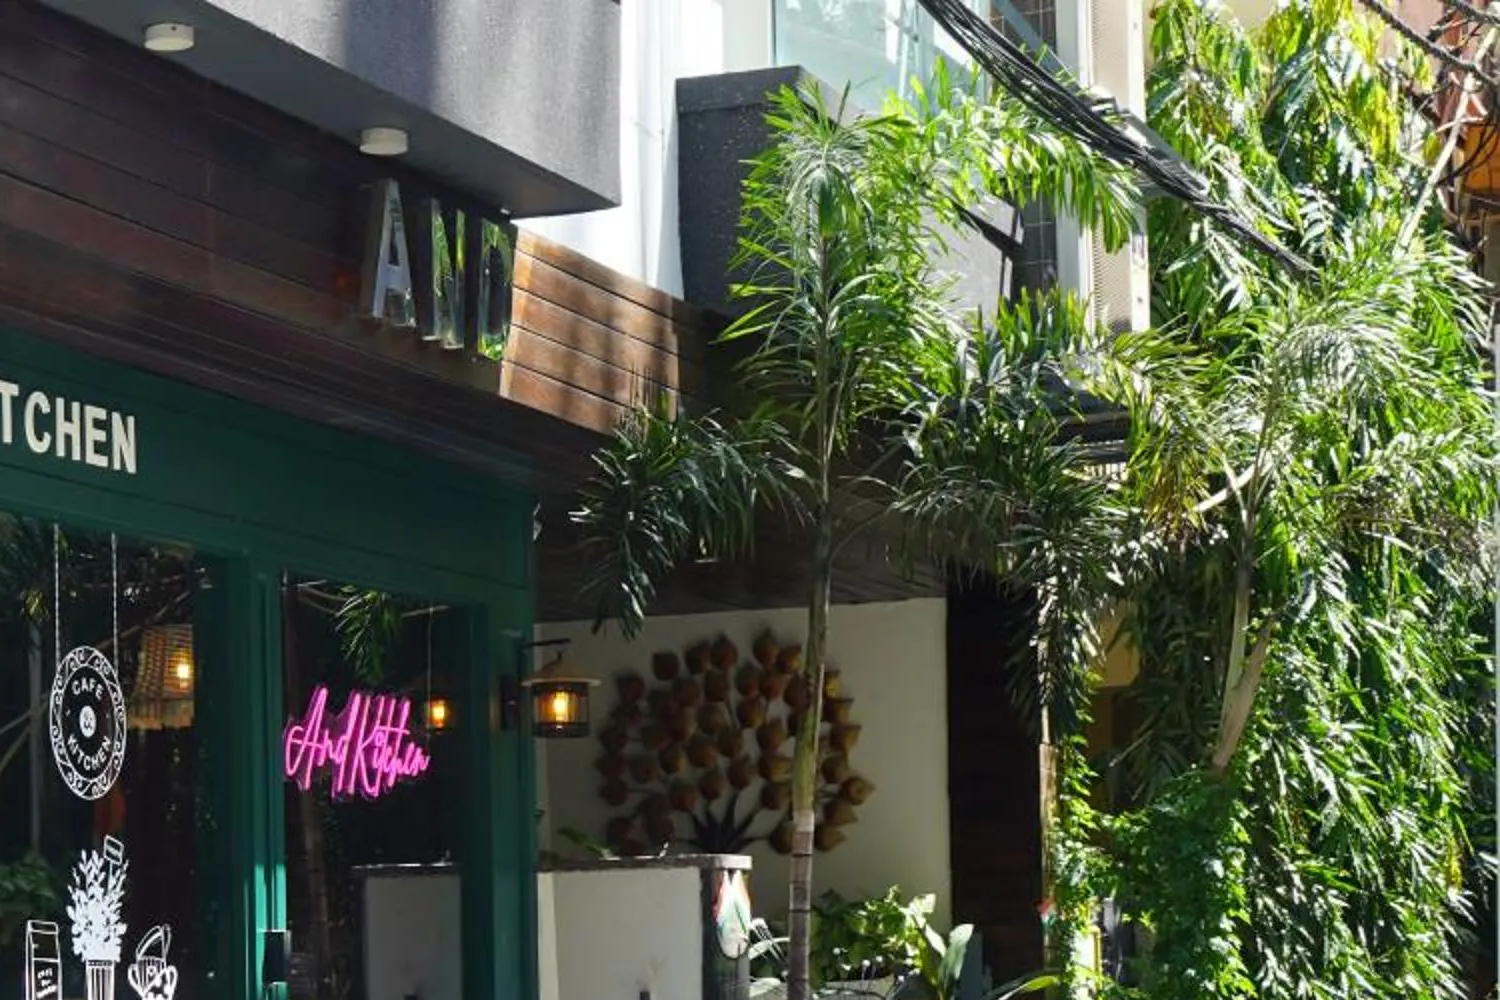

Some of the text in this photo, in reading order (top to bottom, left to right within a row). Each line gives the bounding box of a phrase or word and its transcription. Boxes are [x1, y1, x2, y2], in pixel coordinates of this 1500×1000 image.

[369, 177, 517, 362] AND
[71, 677, 104, 700] CAFE
[67, 734, 111, 770] KITCHEN
